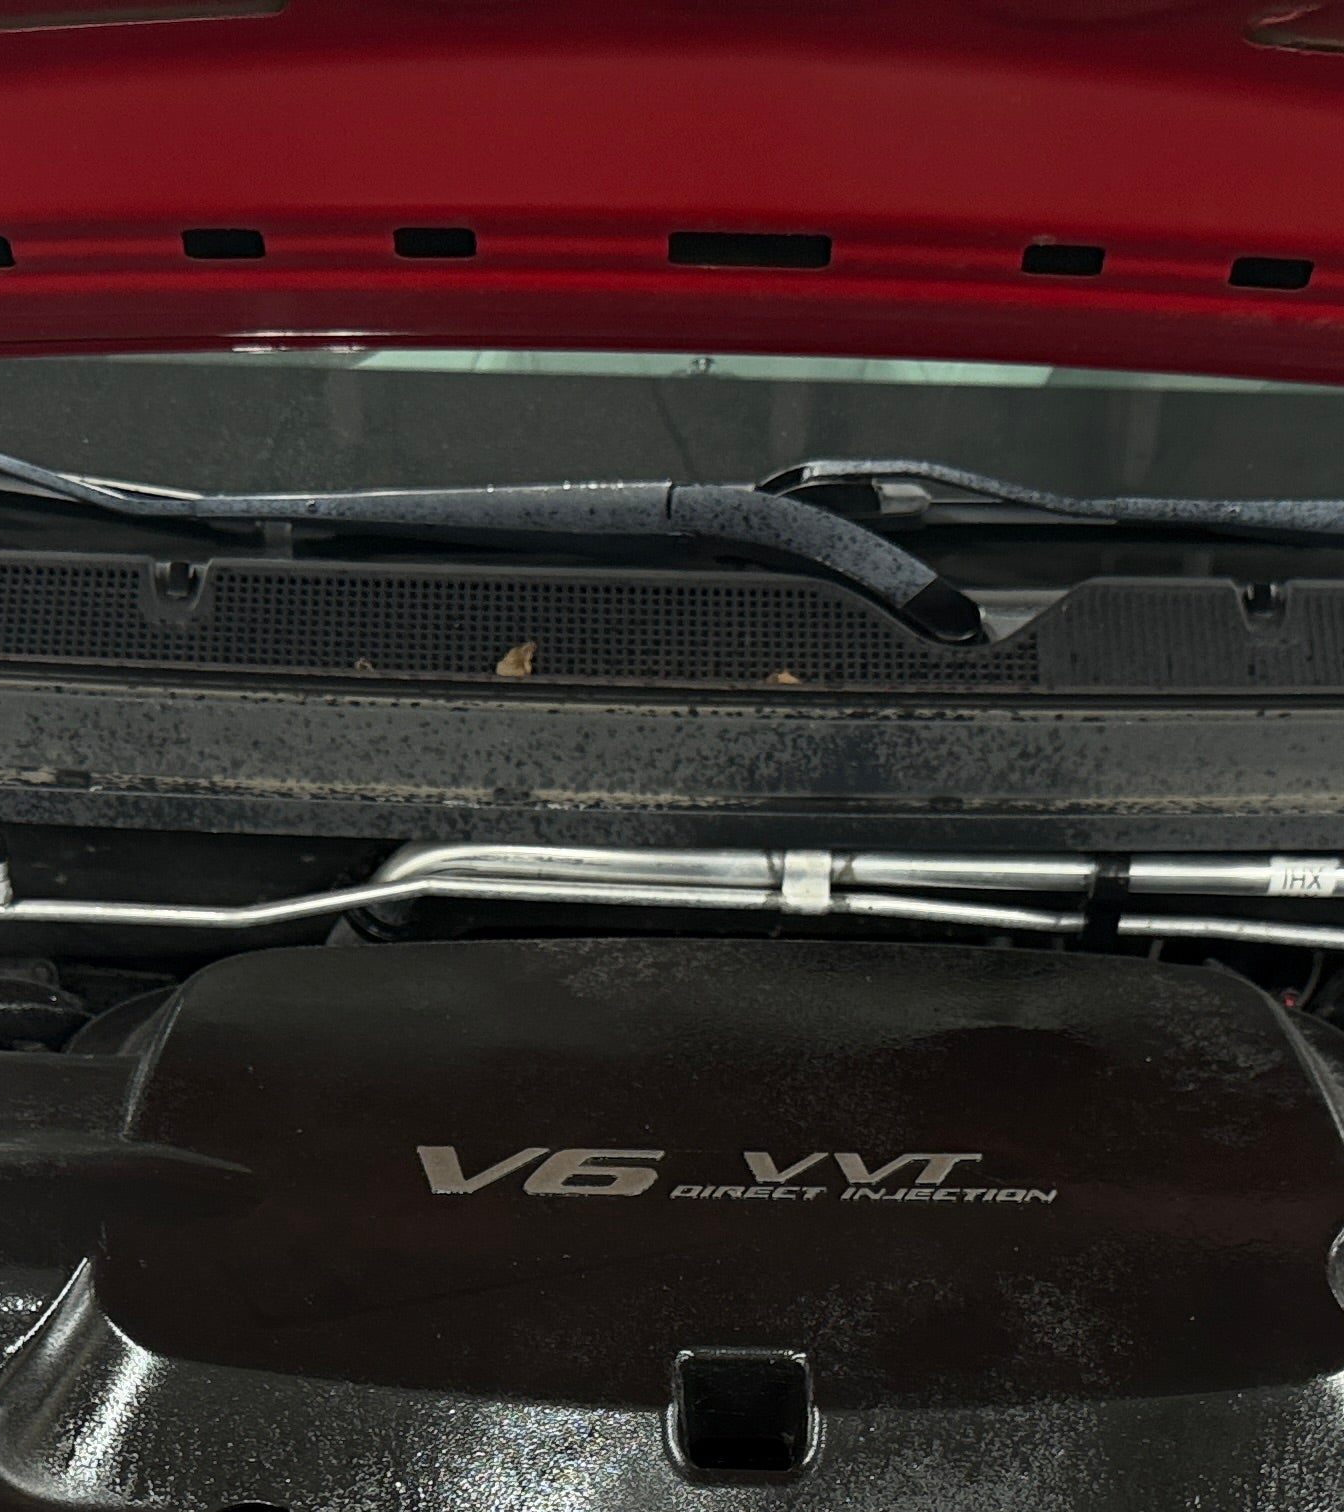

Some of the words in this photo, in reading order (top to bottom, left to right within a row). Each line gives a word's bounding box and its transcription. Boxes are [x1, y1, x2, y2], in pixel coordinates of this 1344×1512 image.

[416, 1145, 665, 1196] V6
[743, 1151, 983, 1185] VVT
[669, 1184, 827, 1200] DIRECT
[840, 1186, 1057, 1203] INJECTION
